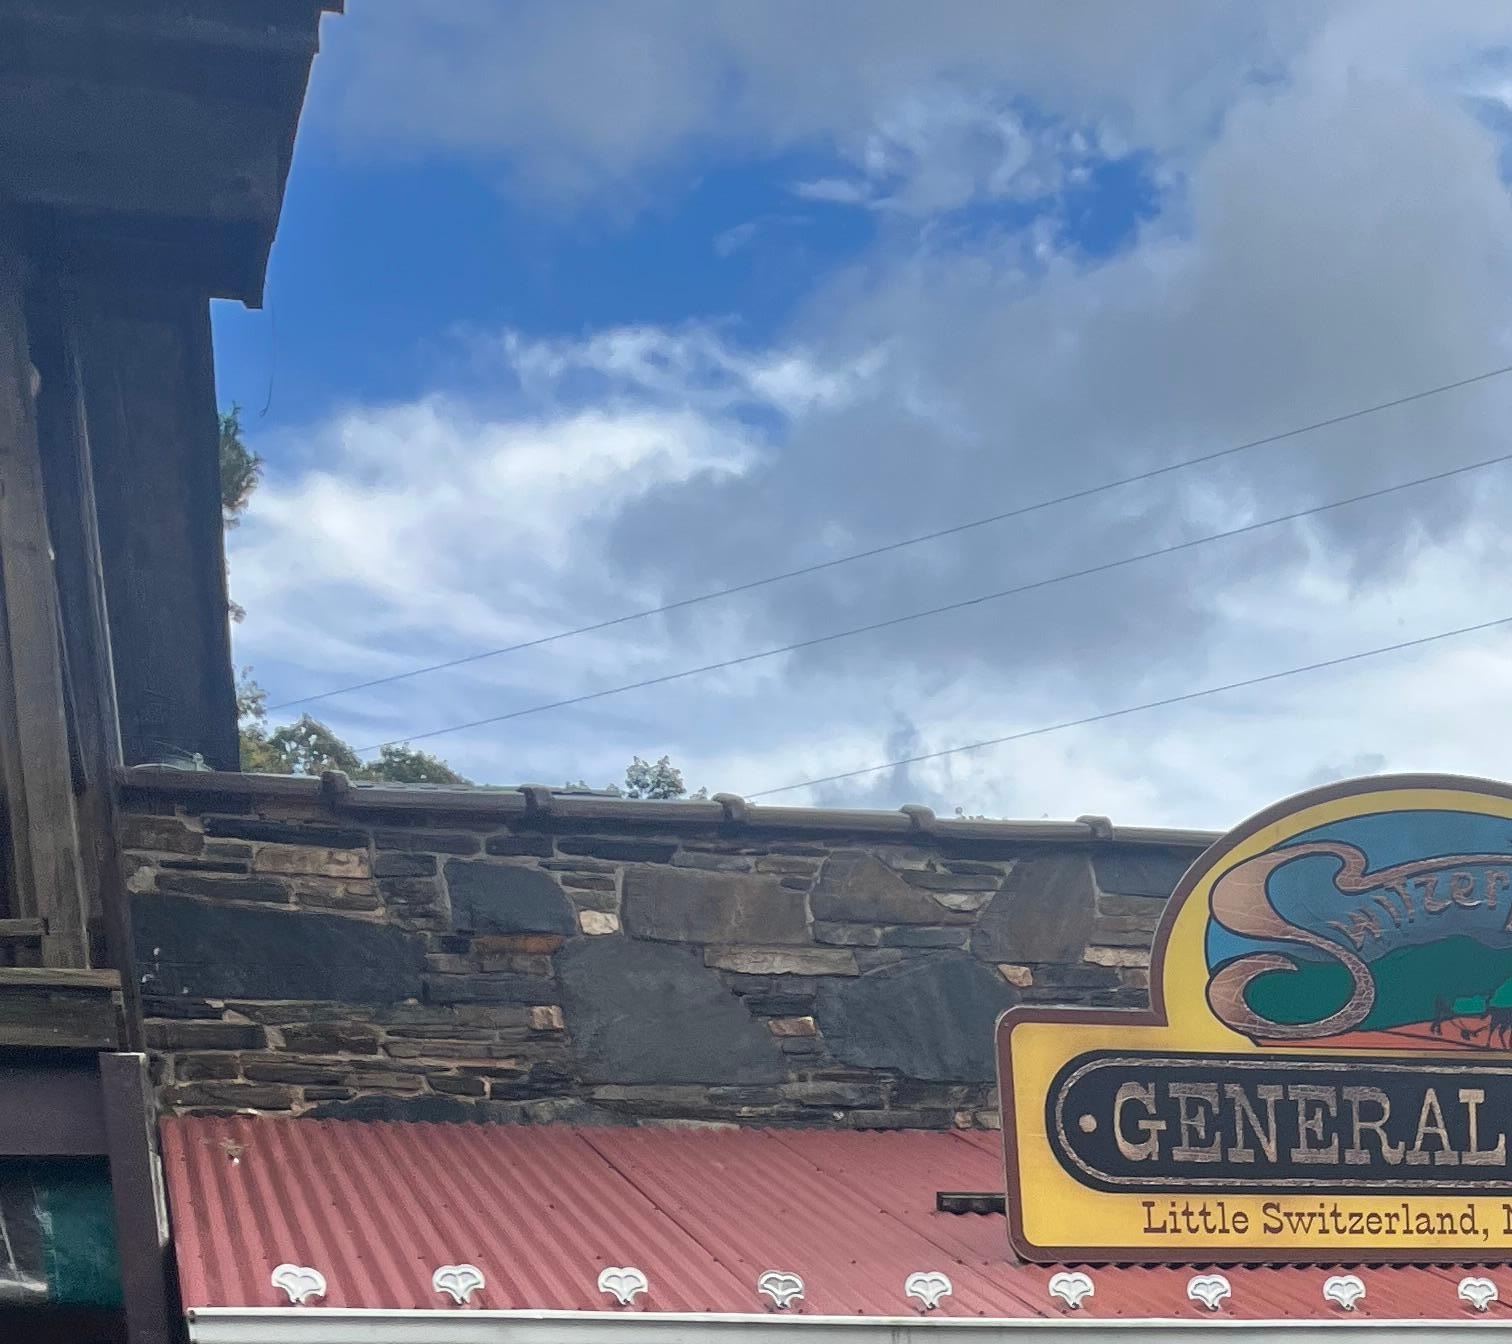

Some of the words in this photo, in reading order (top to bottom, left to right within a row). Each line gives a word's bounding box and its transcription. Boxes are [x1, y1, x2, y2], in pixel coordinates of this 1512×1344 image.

[1113, 1081, 1506, 1167] GENERAL
[1141, 1200, 1249, 1235] Little
[1262, 1201, 1489, 1241] Switzerland,
